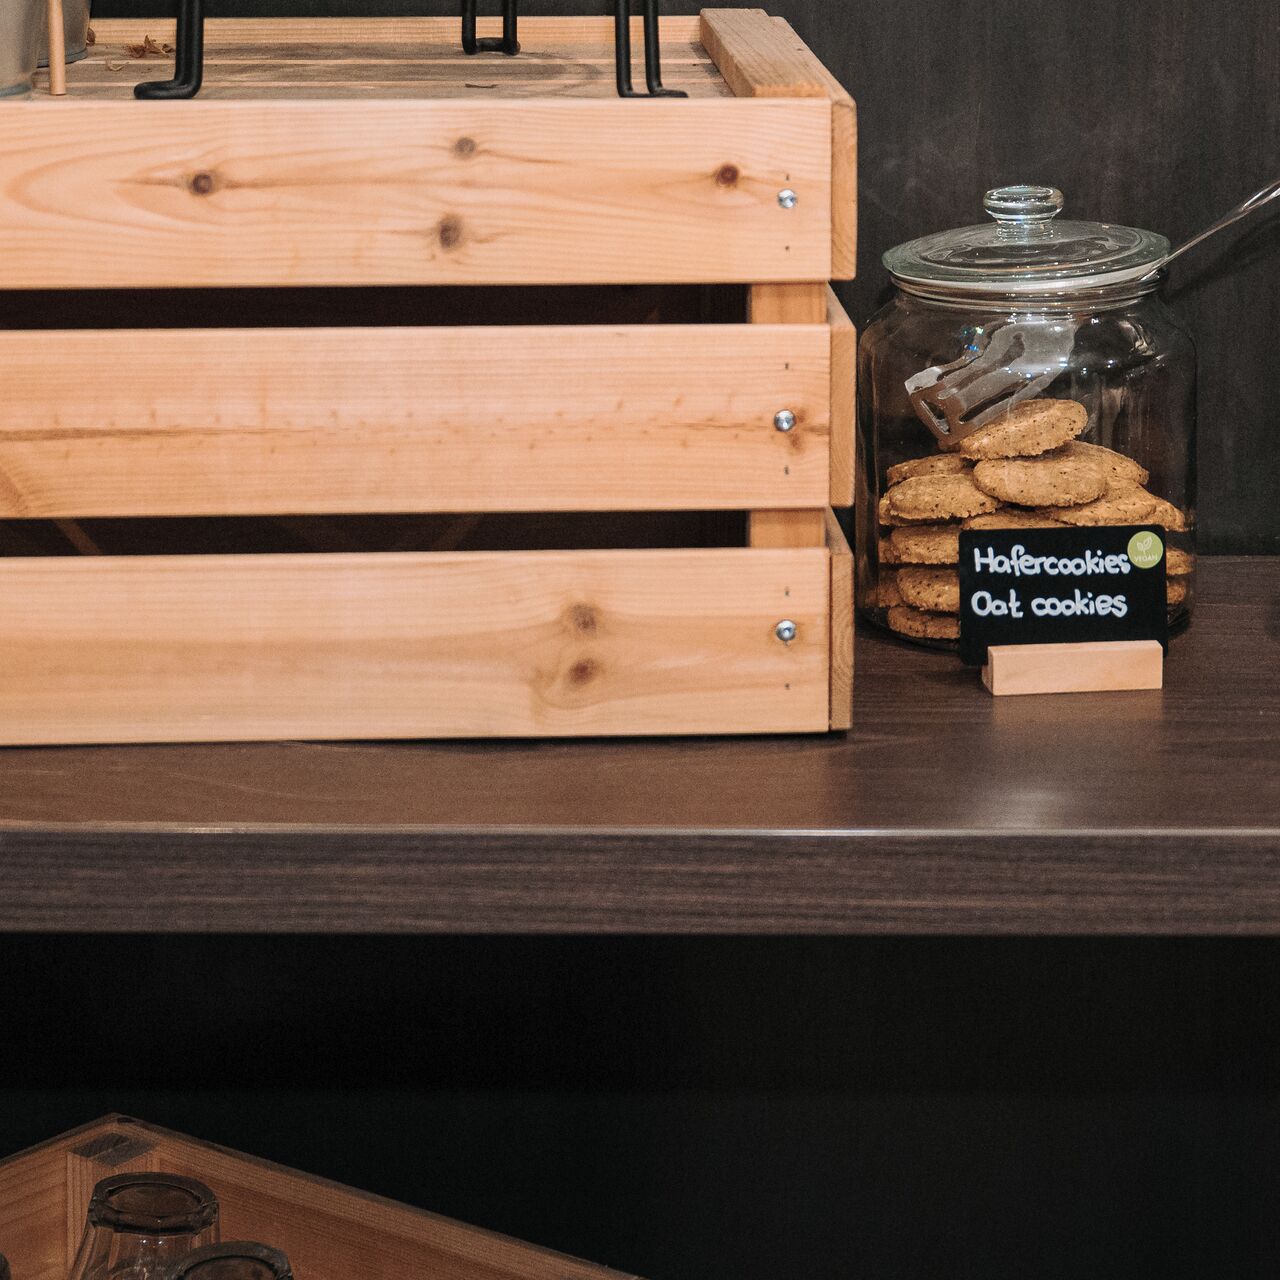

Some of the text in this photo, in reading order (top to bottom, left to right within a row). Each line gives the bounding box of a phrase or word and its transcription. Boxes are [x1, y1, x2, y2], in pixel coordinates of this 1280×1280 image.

[973, 544, 1131, 577] Hafercookies
[1134, 554, 1158, 562] VEGAN
[971, 588, 1128, 618] Oat cookies
